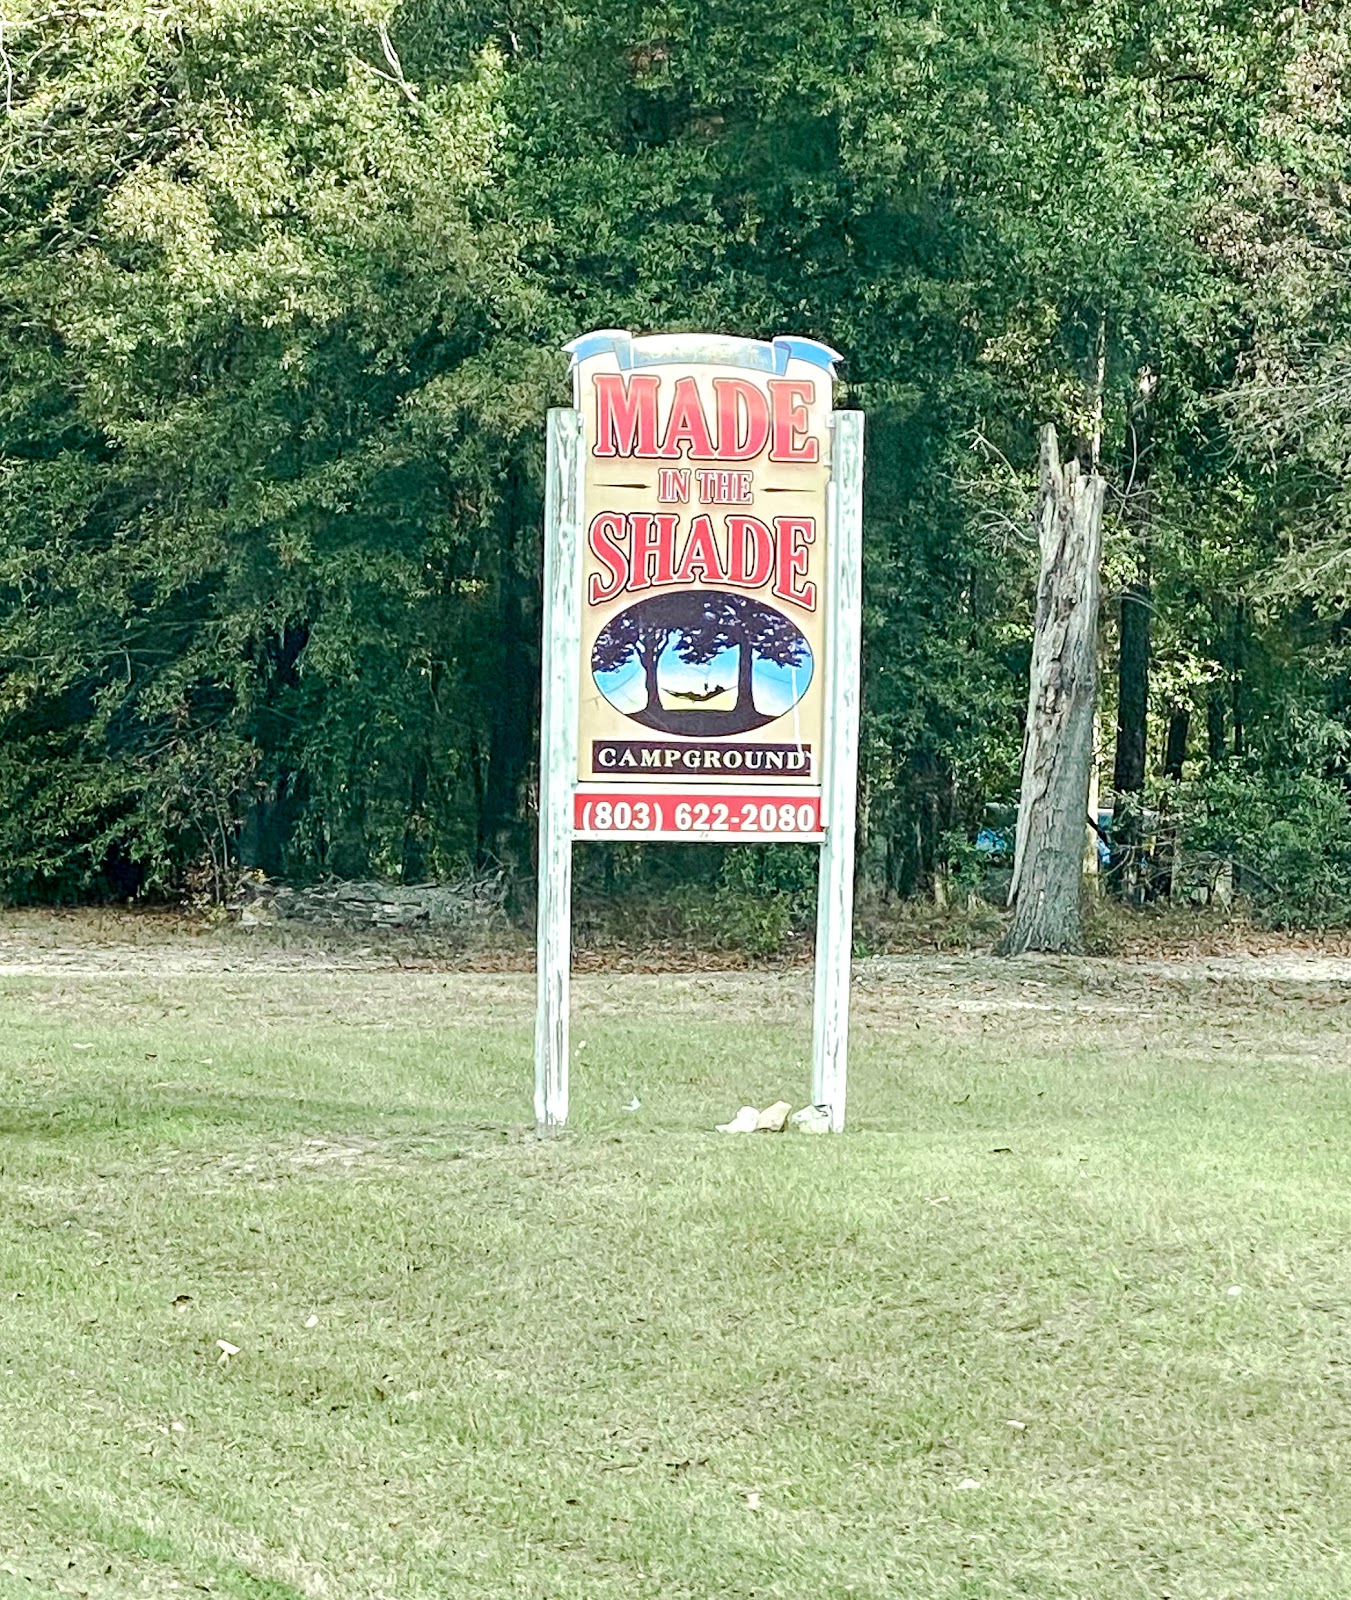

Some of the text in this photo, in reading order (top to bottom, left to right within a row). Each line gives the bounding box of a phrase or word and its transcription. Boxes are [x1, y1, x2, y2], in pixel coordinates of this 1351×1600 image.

[592, 373, 819, 463] MADE
[658, 468, 754, 505] IN THE
[588, 511, 816, 612] SHADE
[598, 747, 806, 770] CAMPGROUND
[582, 801, 816, 832] (803) 622-2080
